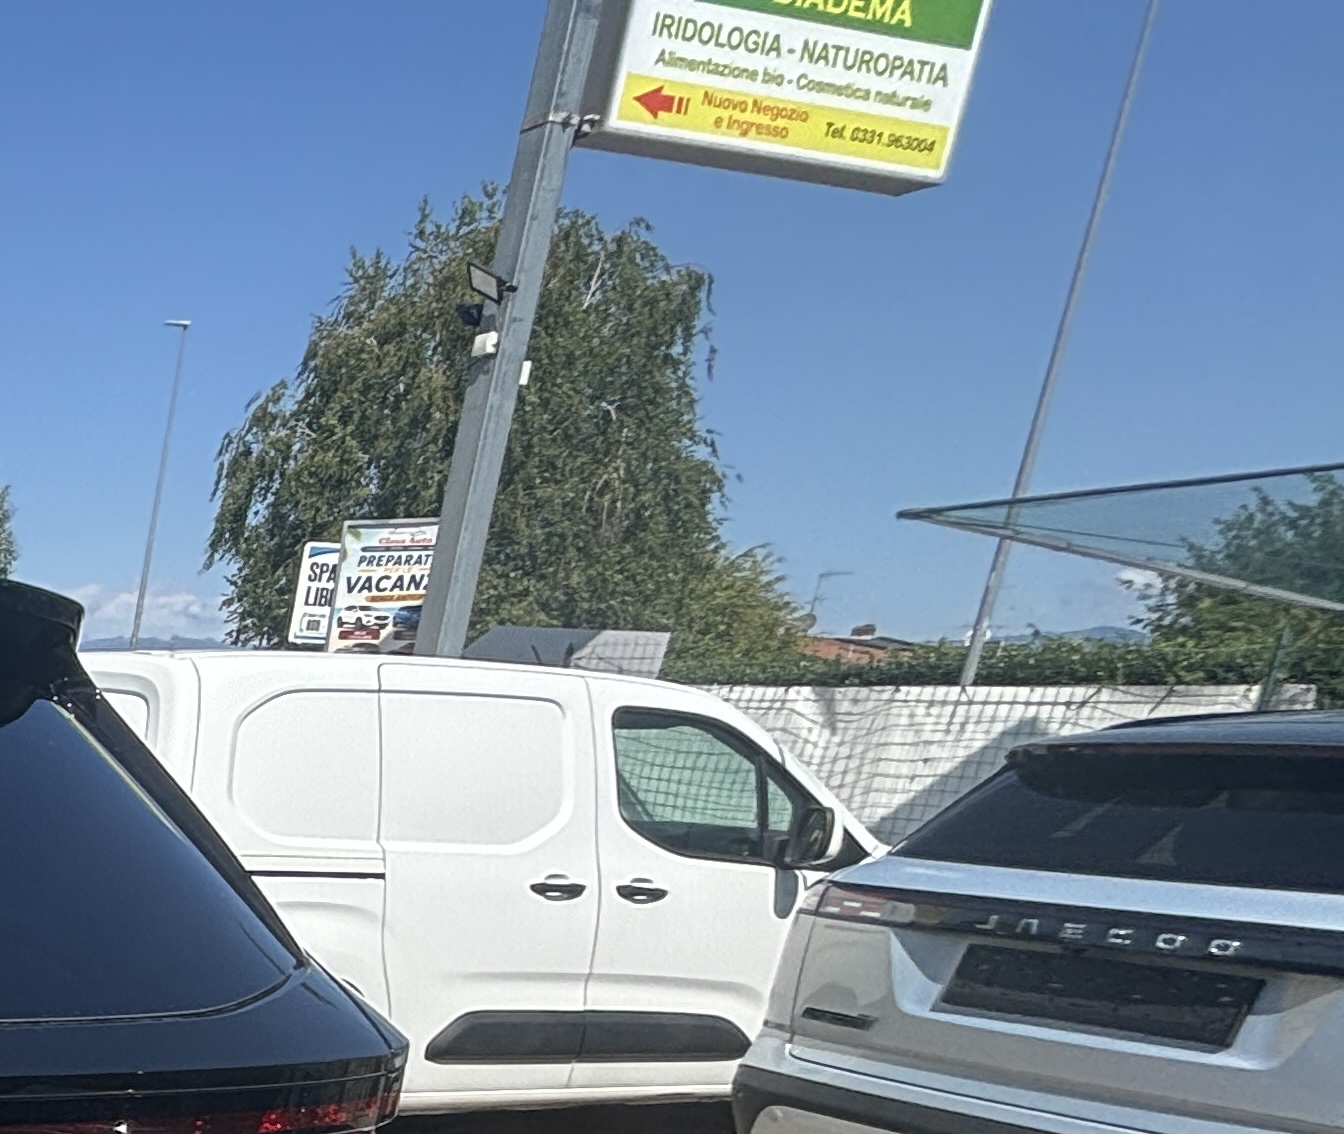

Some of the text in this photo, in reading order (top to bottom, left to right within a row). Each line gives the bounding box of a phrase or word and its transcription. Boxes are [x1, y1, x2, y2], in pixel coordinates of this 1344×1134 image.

[772, 0, 912, 28] DEMA
[651, 11, 781, 58] IRIDOLOGIA
[799, 38, 948, 87] NATUROPATIA
[654, 48, 759, 82] Alimentazione
[762, 67, 785, 86] bio
[796, 73, 871, 101] Cosmetica
[874, 90, 933, 112] naturale
[702, 90, 809, 122] Nuovo Negozio
[714, 115, 789, 139] e Ingresso
[824, 122, 846, 140] Tel.
[974, 914, 1241, 956] JAECOO
